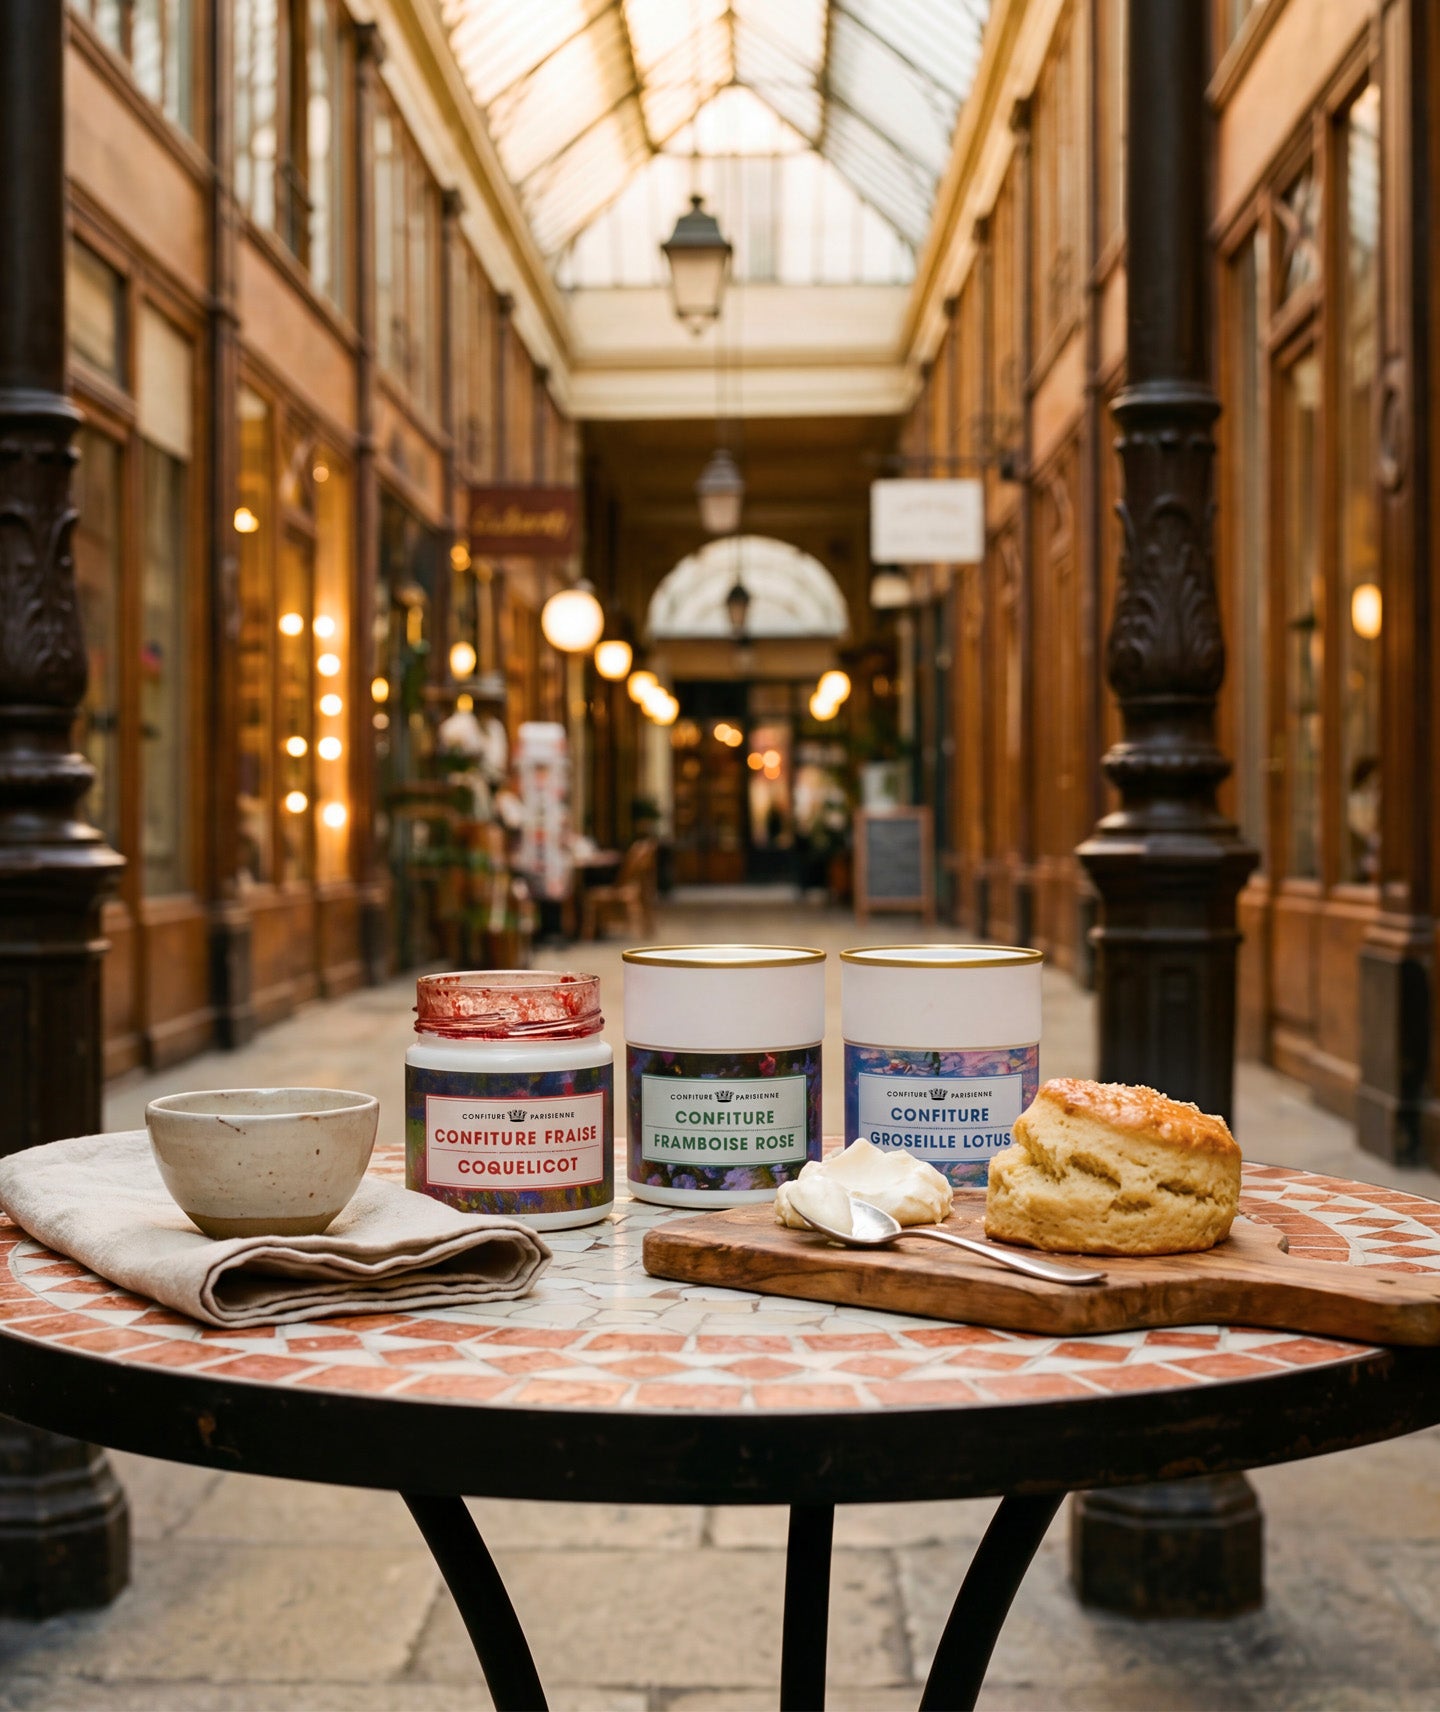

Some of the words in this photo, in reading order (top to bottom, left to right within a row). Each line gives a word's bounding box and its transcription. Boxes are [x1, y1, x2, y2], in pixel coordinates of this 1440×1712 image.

[735, 1092, 780, 1101] PARISIENNE
[886, 1090, 928, 1098] CONFITURE
[951, 1090, 993, 1099] PARISIENNE
[462, 1112, 506, 1120] CONFITURE
[530, 1111, 575, 1120] PARISIENNE
[675, 1110, 774, 1125] CONFITURE
[890, 1107, 989, 1122] CONFITURE
[434, 1128, 536, 1146] CONFITURE
[545, 1125, 597, 1145] FRAISE
[654, 1133, 748, 1151] FRAMBOISE
[755, 1133, 794, 1150] ROSE
[870, 1131, 955, 1149] GROSEILLE
[963, 1132, 1011, 1148] LOTUS
[458, 1157, 578, 1175] COQUELICOT
